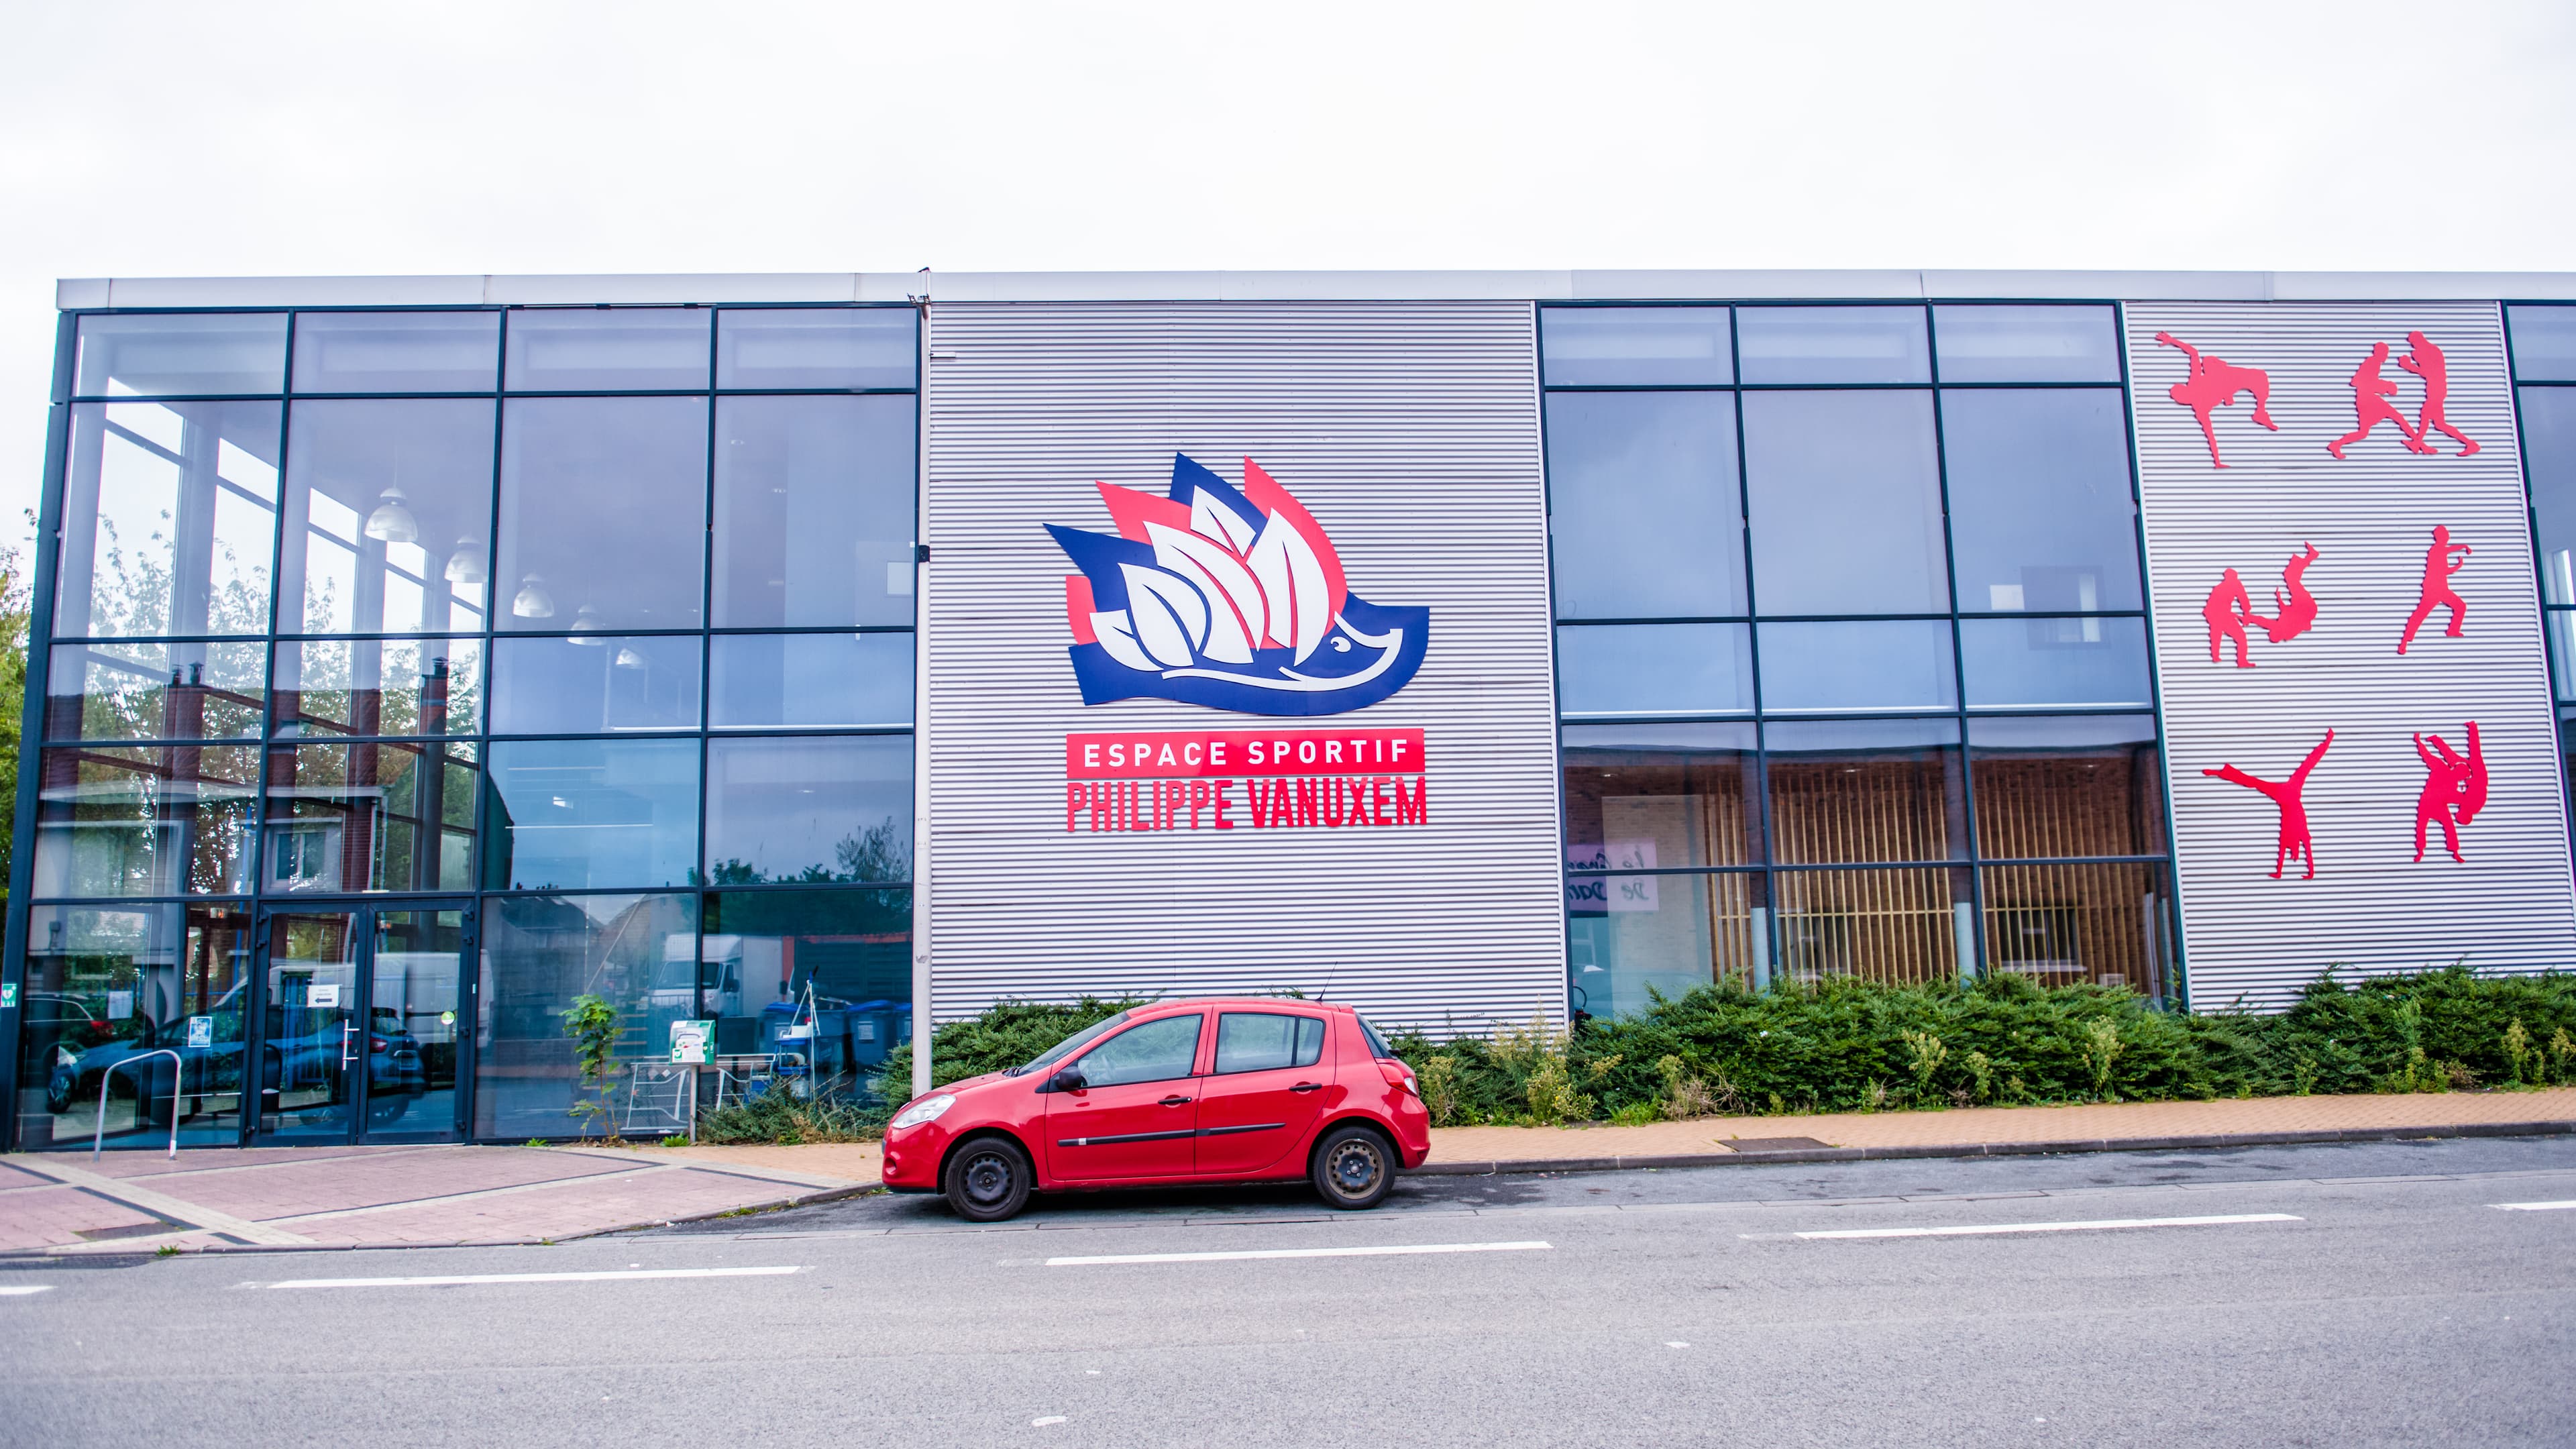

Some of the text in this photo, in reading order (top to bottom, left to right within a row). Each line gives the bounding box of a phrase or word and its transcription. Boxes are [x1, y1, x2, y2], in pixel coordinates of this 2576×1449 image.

[1084, 739, 1407, 767] ESPACE SPORTIF
[1067, 776, 1427, 832] PHILIPPE VANUXEM
